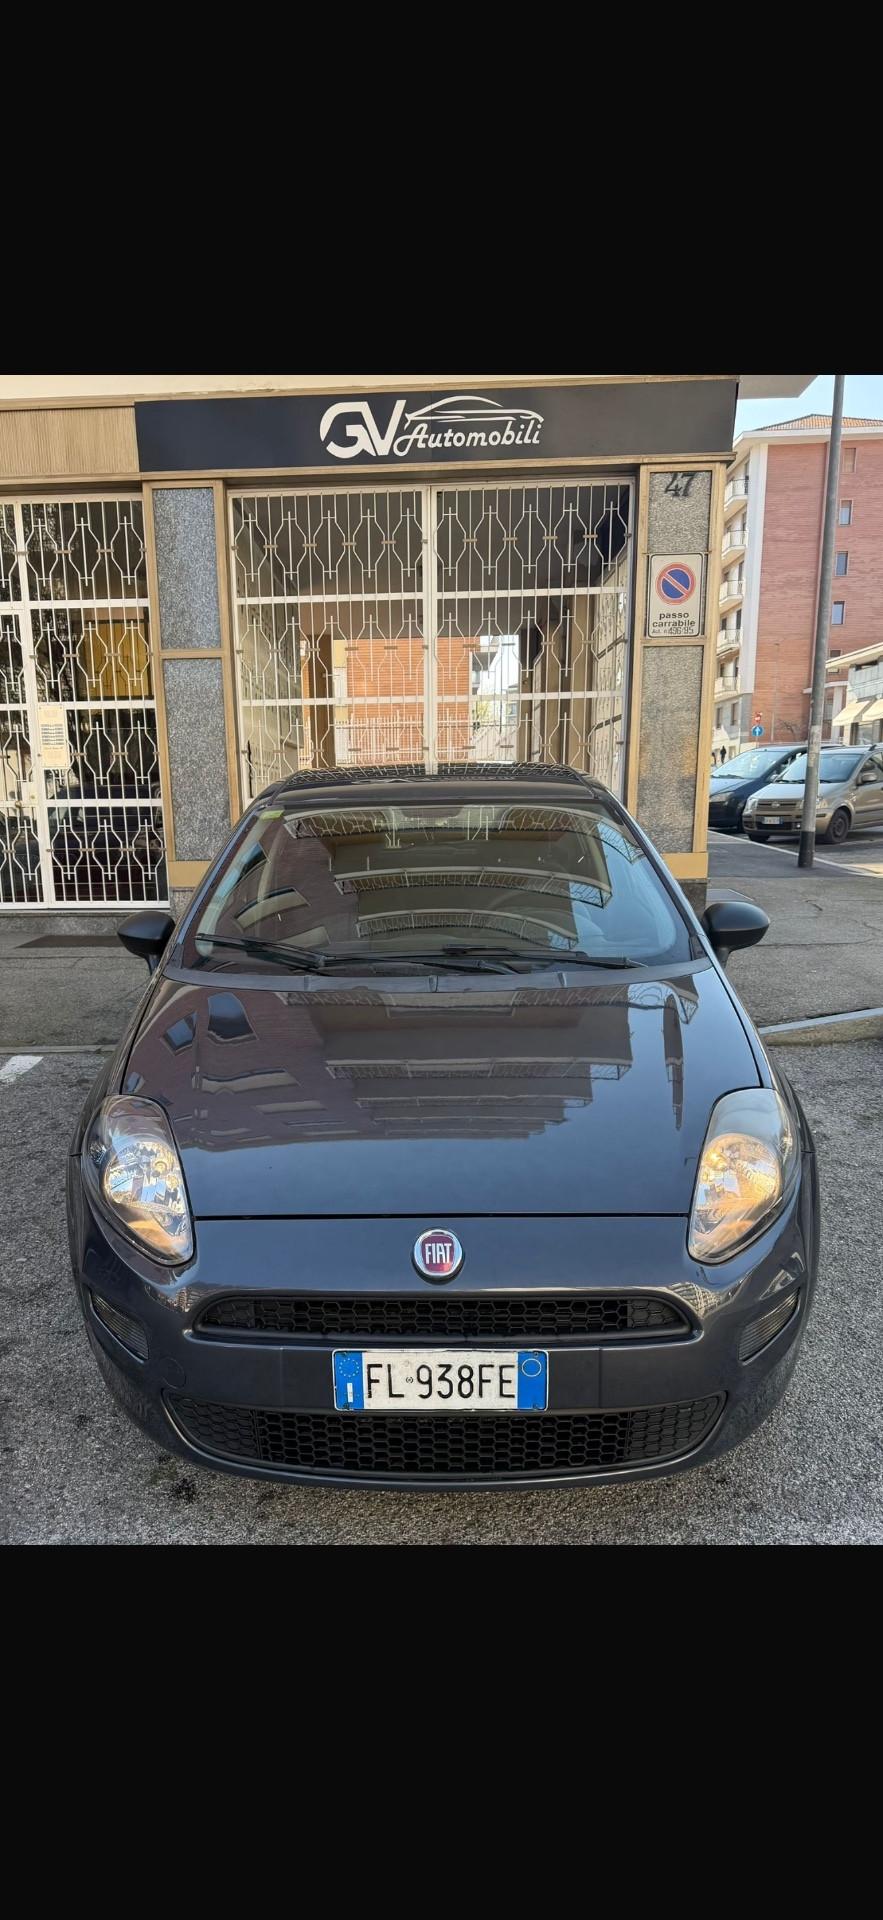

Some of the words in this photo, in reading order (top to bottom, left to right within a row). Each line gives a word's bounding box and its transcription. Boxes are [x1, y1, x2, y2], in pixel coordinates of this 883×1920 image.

[319, 400, 407, 459] GV
[393, 419, 543, 457] Automobili
[664, 471, 697, 497] 47
[652, 620, 696, 628] carrabile
[659, 612, 690, 620] passo
[424, 1242, 452, 1265] FIAT
[367, 1363, 405, 1399] FL
[416, 1363, 516, 1400] 938FE
